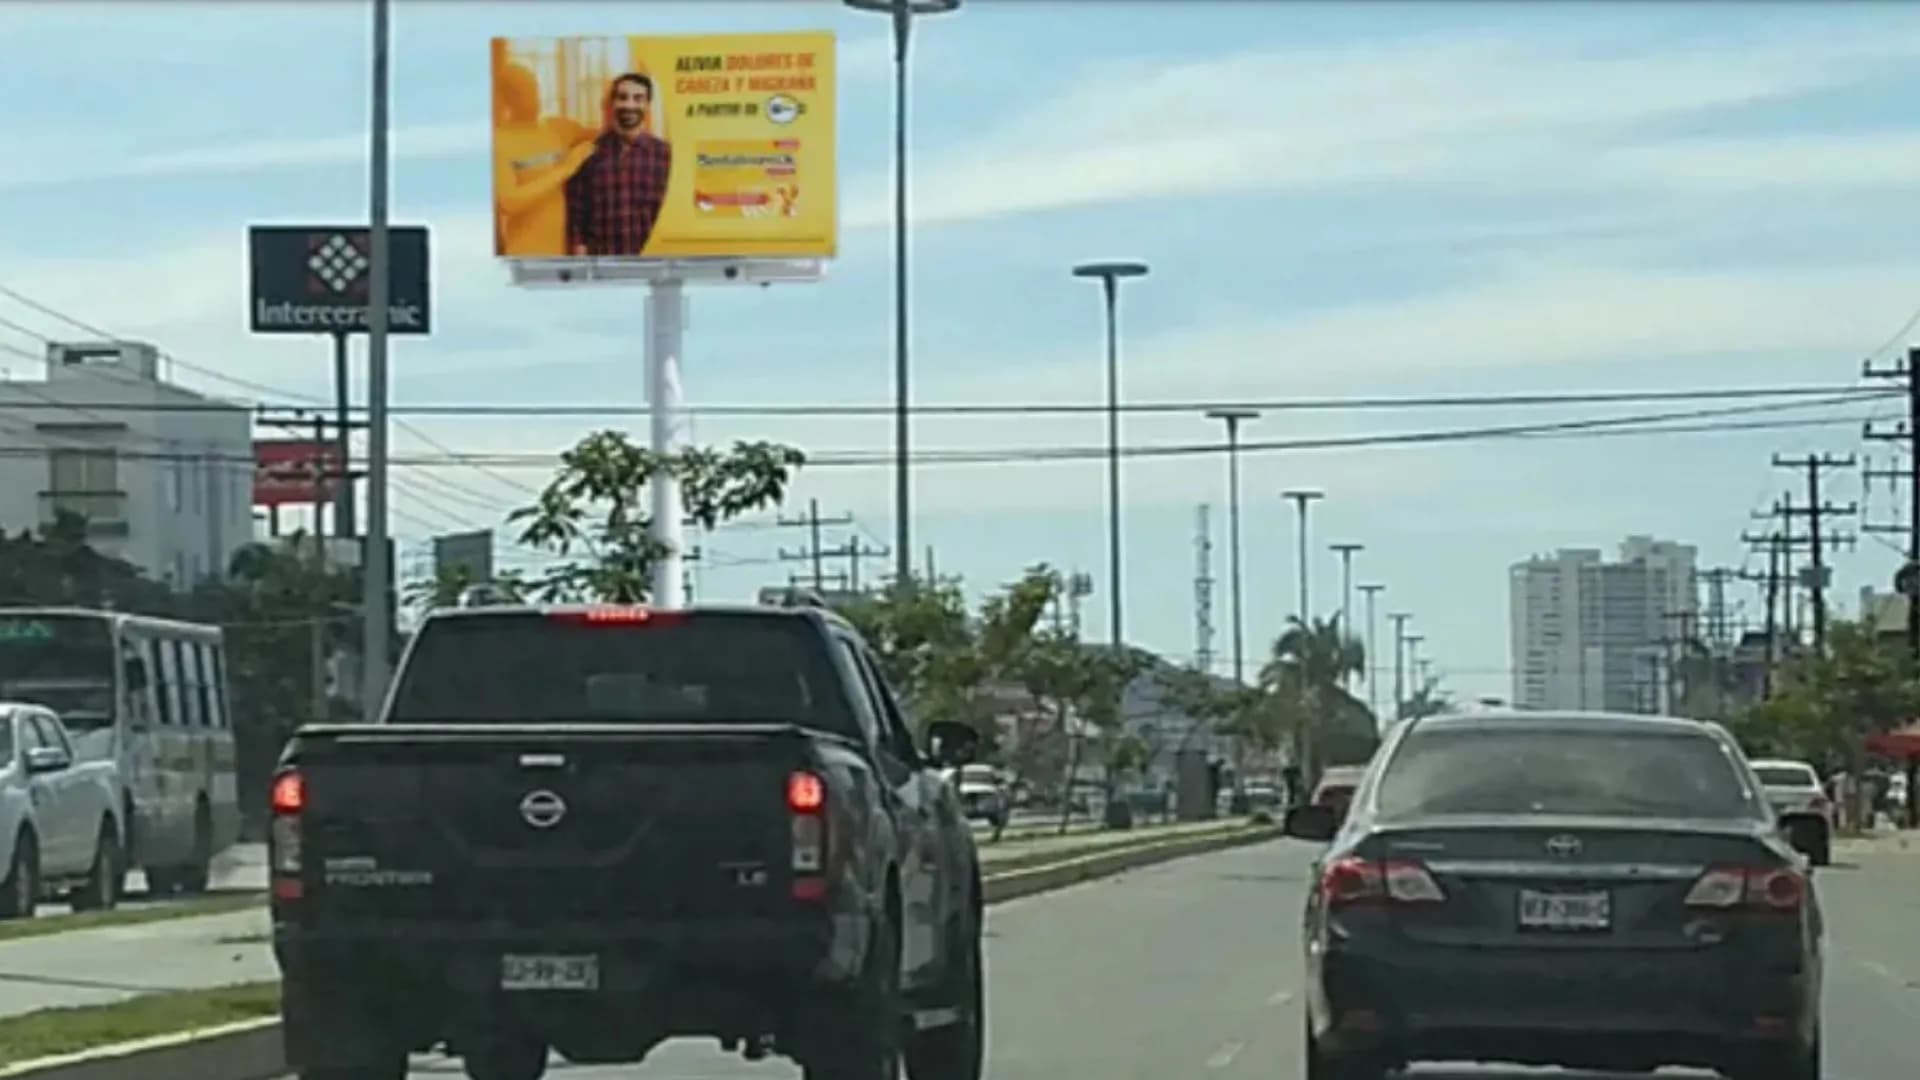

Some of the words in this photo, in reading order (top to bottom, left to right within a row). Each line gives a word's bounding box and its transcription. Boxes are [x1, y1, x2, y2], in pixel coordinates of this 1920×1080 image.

[675, 55, 722, 71] ALIVIA
[726, 54, 793, 70] DOLORES
[797, 53, 816, 67] DE
[675, 78, 730, 94] CABEZA
